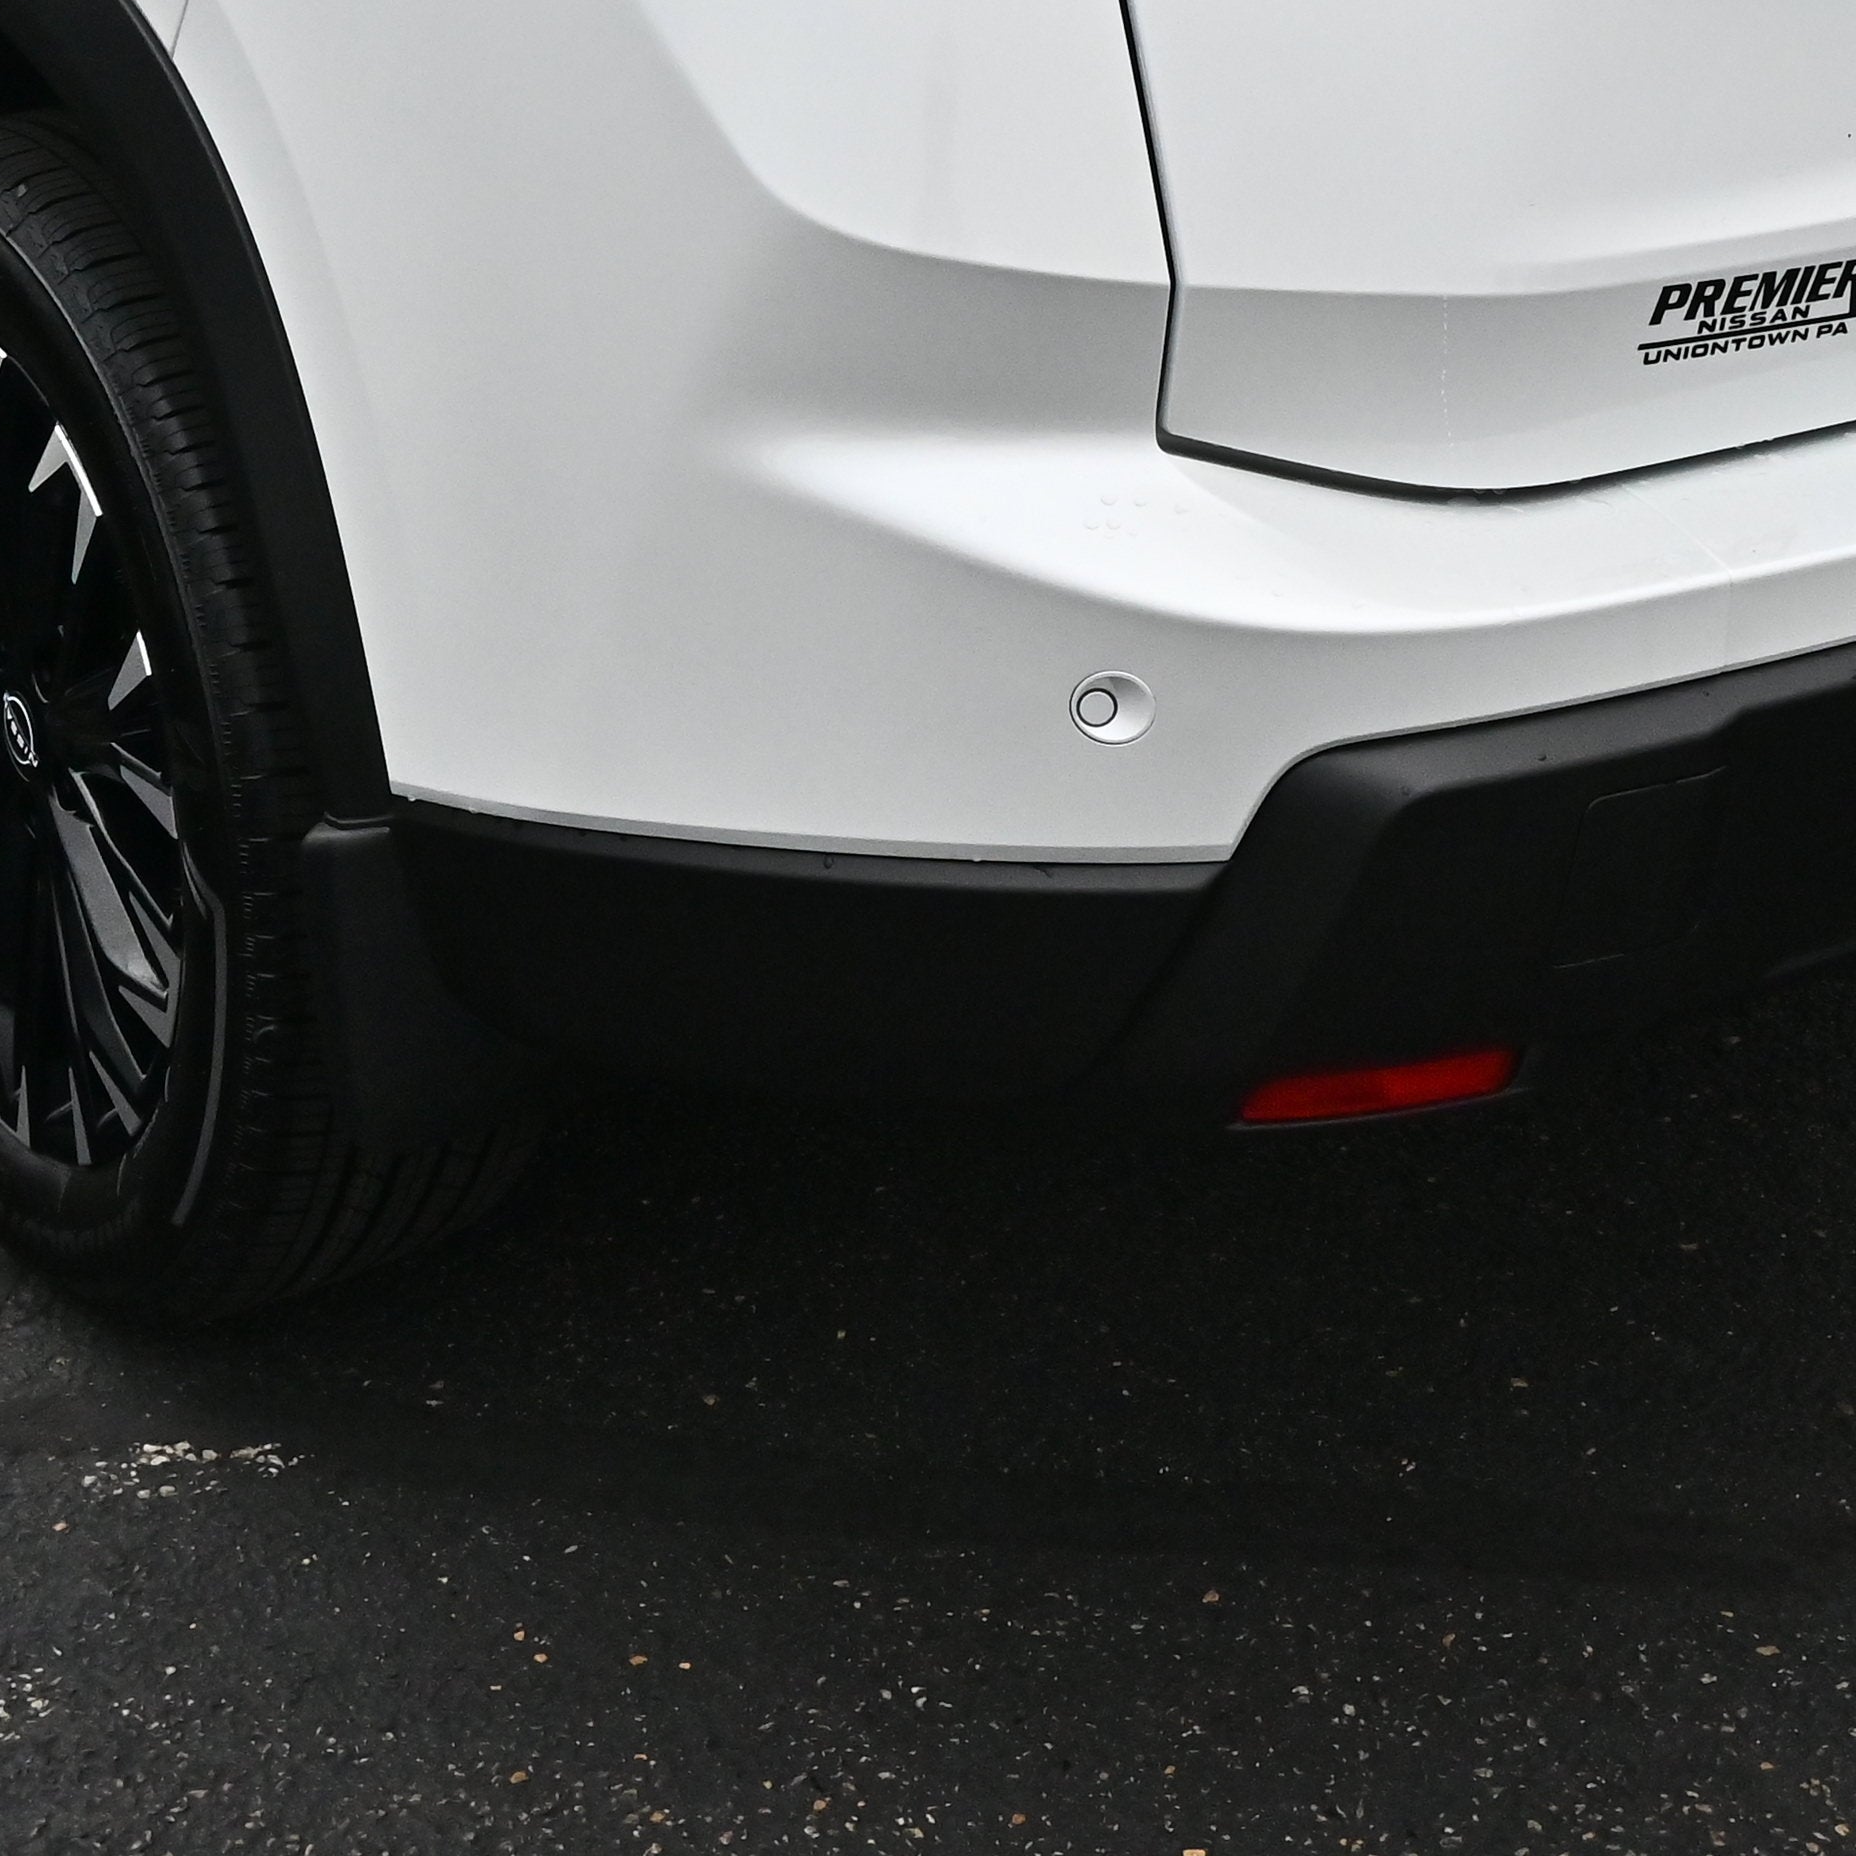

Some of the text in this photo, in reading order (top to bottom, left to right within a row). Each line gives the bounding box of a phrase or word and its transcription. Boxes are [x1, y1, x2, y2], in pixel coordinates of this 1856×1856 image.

[1698, 305, 1811, 334] NISSAN
[1643, 322, 1849, 365] UNIONTOWN PA
